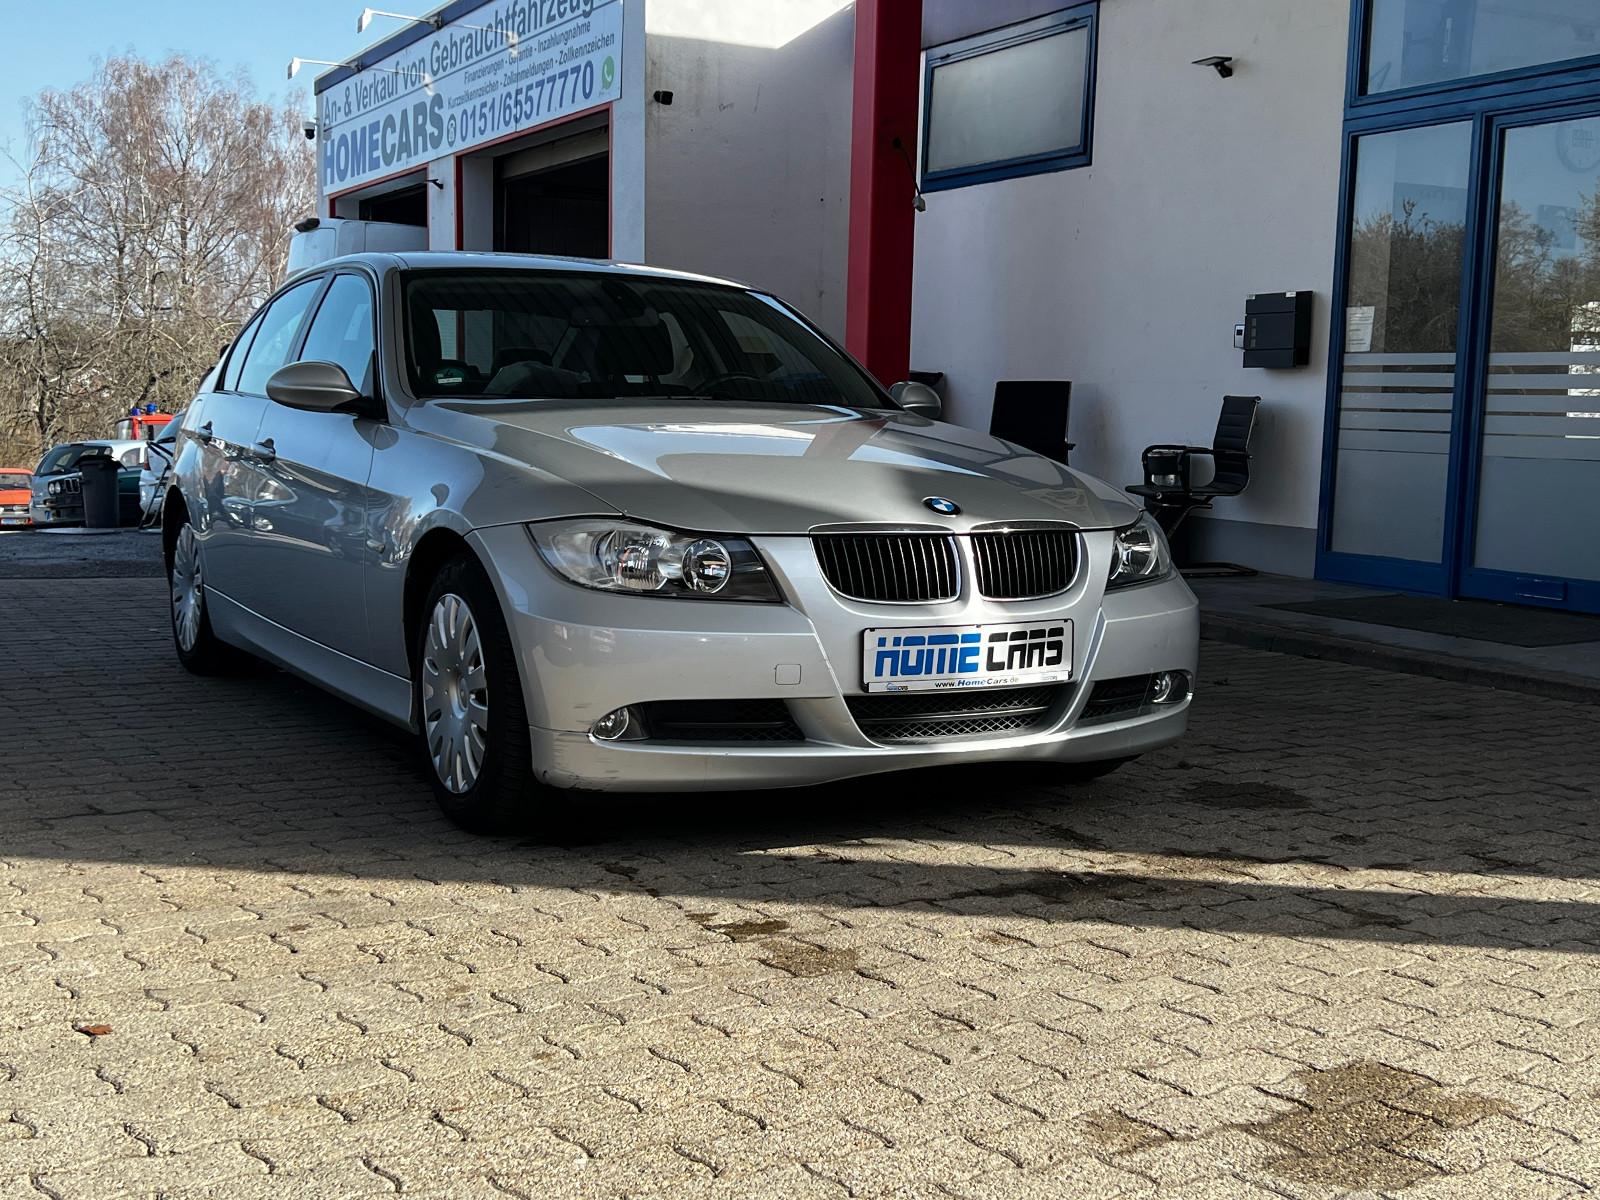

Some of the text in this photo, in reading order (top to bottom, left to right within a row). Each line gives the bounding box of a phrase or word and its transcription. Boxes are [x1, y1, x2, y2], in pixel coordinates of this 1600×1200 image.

[464, 58, 504, 85] Finanzierungen
[538, 20, 591, 53] Inzahlungnahme
[503, 58, 554, 88] Zollanmeldungen
[559, 32, 615, 65] Zollkennzeichen
[344, 86, 352, 118] &
[355, 61, 400, 112] Verkauf
[402, 56, 426, 90] von
[460, 60, 594, 143] 0151/65577770
[874, 626, 1065, 677] HOME CARS
